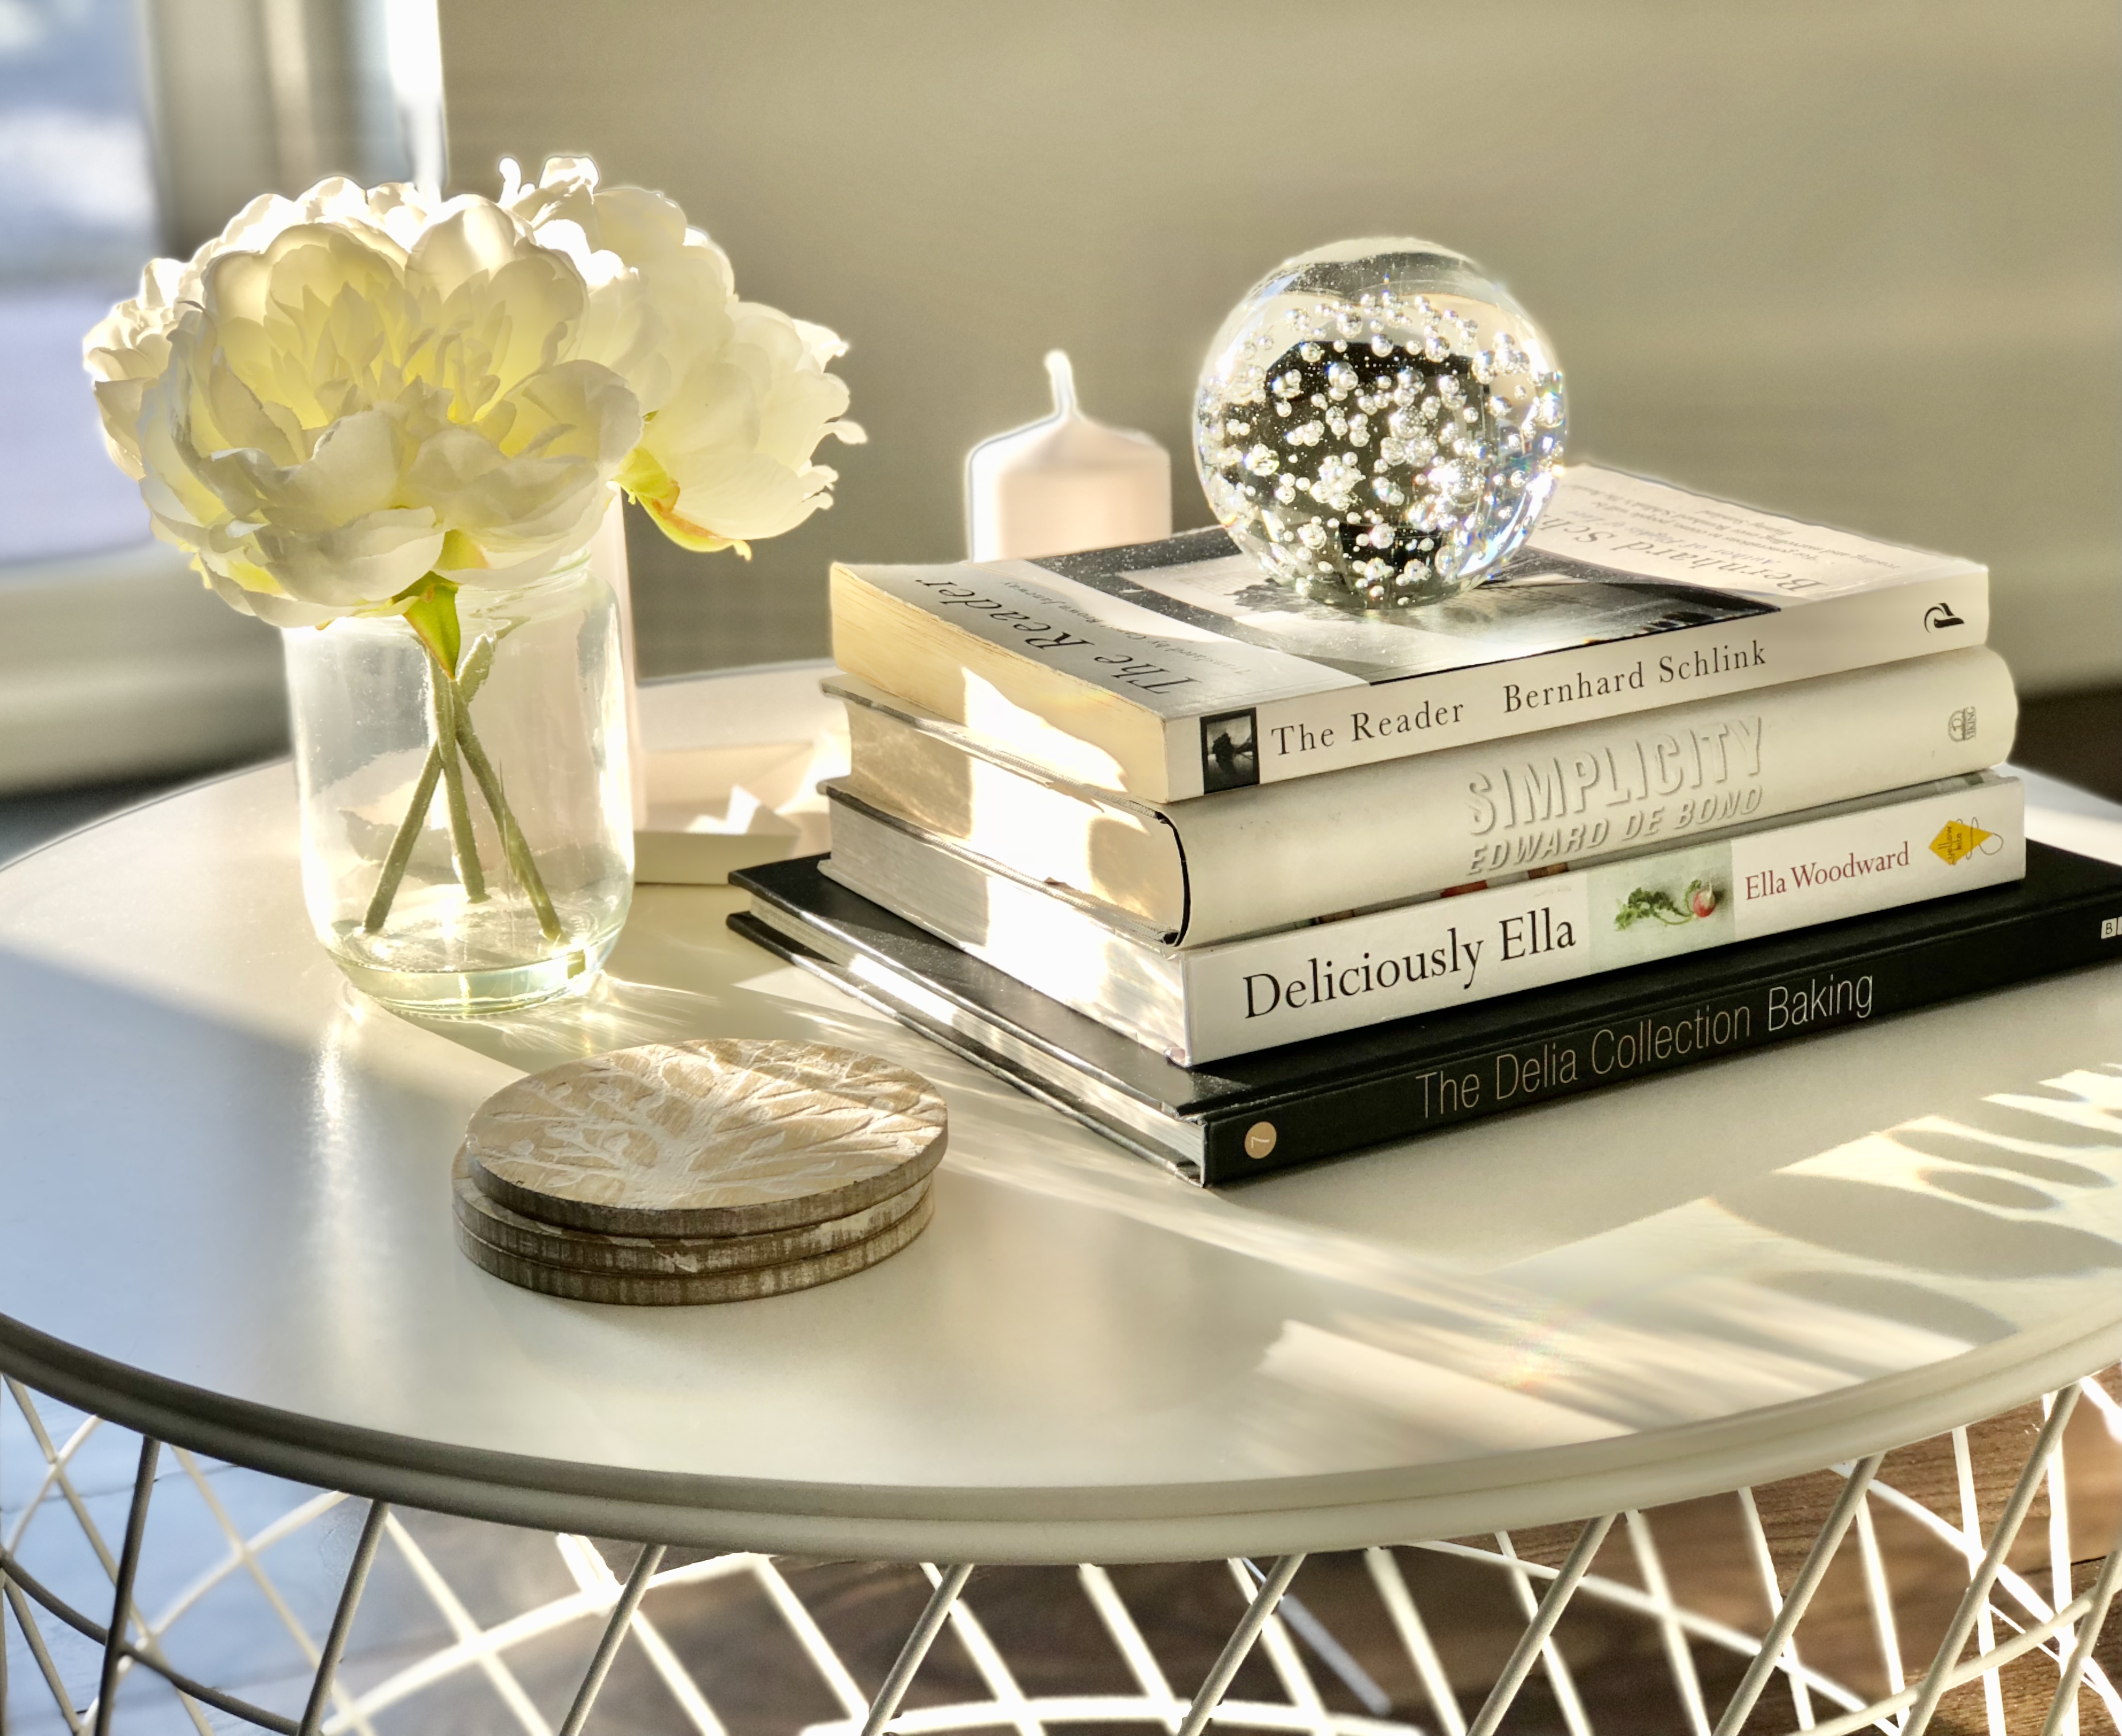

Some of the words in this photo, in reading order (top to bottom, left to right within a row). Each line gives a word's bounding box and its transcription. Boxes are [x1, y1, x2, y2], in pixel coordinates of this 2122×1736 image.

[1610, 541, 1828, 591] Bernhard
[915, 579, 1095, 650] Reader
[1095, 654, 1202, 694] The
[1270, 723, 1335, 757] The
[1350, 700, 1464, 742] Reader
[1503, 661, 1645, 713] Bernhard
[1658, 640, 1767, 684] Schlink
[1467, 716, 1763, 836] SIMPLICITY
[1466, 818, 1610, 875] EDWARD
[1620, 805, 1666, 841] DE
[1673, 785, 1764, 830] BONO
[1745, 870, 1787, 900] Ella
[1790, 840, 1911, 889] Woodward
[1242, 927, 1484, 1019] Deliciously
[1498, 907, 1576, 962] Ella
[1415, 1071, 1481, 1119] The
[1495, 1042, 1578, 1101] Delia
[1591, 1005, 1751, 1075] Collection
[1767, 974, 1873, 1032] Baking
